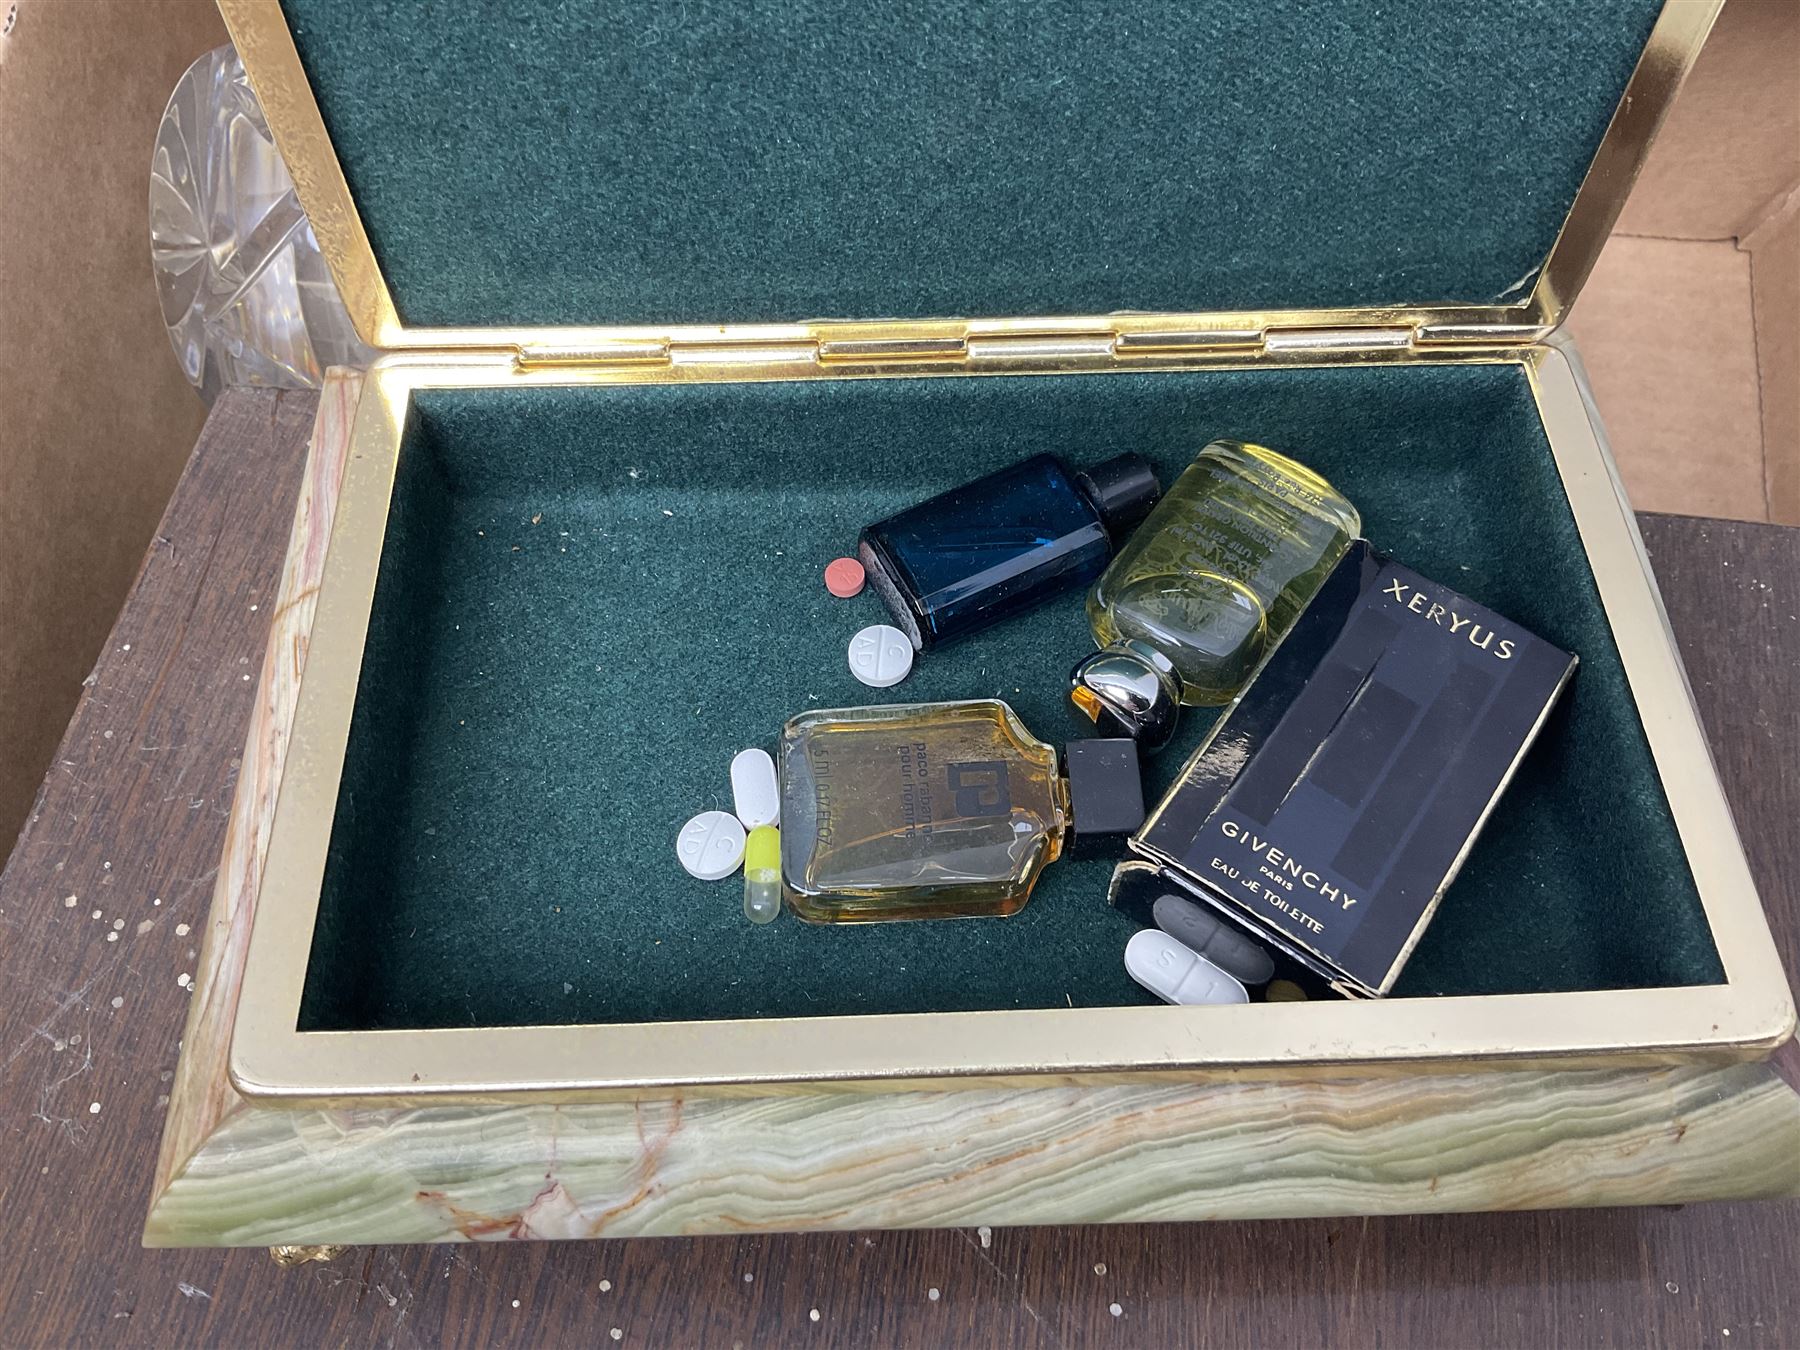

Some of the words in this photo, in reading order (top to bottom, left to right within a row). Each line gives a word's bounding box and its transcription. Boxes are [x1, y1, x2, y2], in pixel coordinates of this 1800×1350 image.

[1382, 578, 1515, 659] XERYUS
[814, 750, 829, 758] 5
[814, 761, 833, 778] ml
[897, 745, 912, 781] pour
[913, 742, 929, 777] paco
[815, 784, 831, 806] 017
[902, 783, 916, 840] homme
[1221, 821, 1357, 910] GIVENCHY
[1259, 865, 1294, 891] PARIS
[1210, 857, 1240, 879] EAU
[1241, 877, 1261, 894] DE
[1262, 888, 1325, 935] TOILETTE
